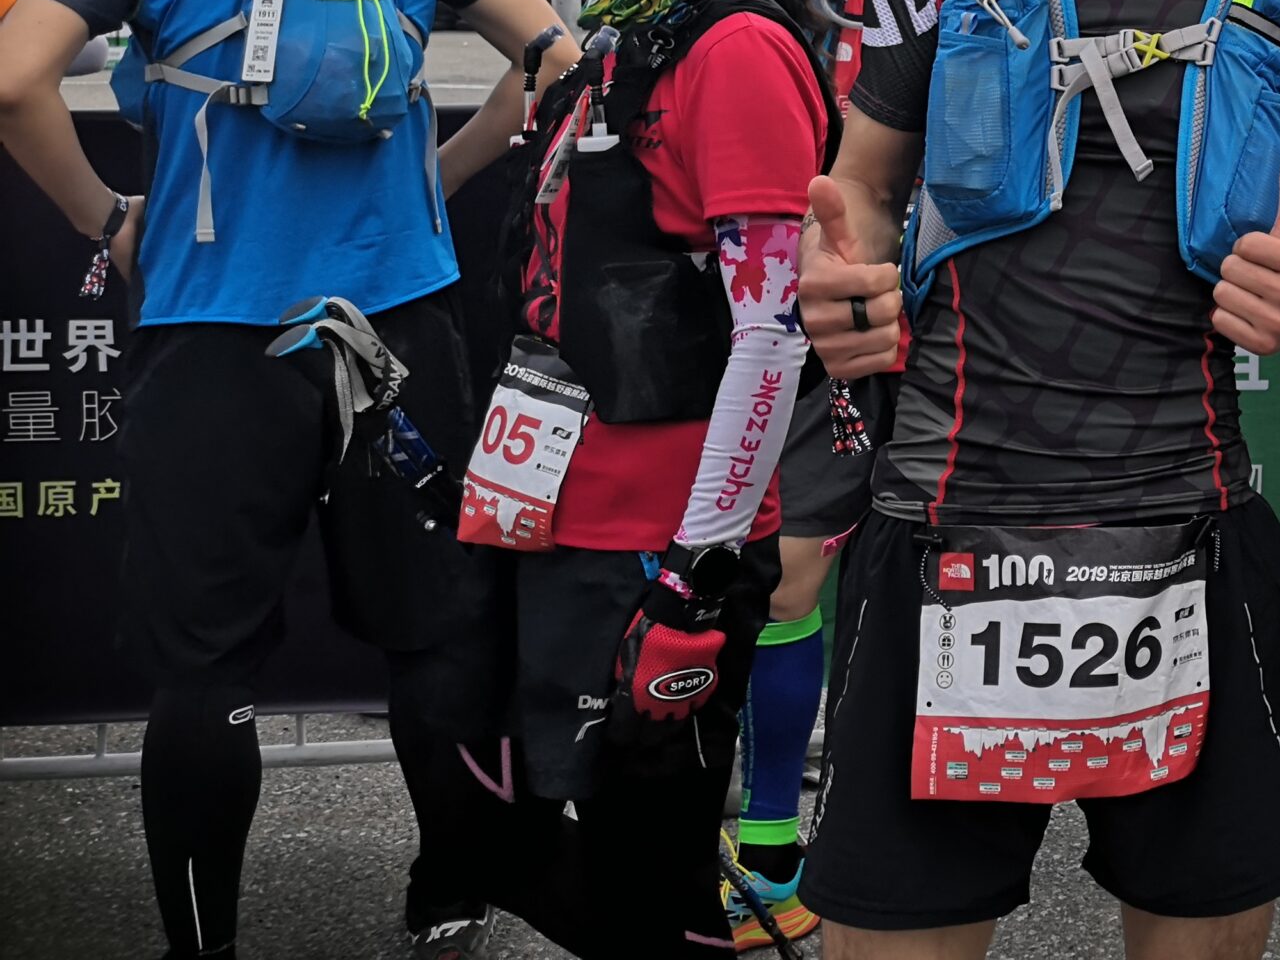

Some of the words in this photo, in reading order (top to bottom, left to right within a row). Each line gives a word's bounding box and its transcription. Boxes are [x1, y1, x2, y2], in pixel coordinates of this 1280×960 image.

[257, 10, 275, 18] 1911
[0, 319, 122, 373] 世界
[2, 388, 122, 442] 量胶
[745, 369, 783, 434] ZONE
[481, 404, 543, 465] 05
[982, 554, 1054, 590] 100
[1065, 566, 1108, 582] 2019
[970, 615, 1163, 688] 1526
[670, 675, 707, 692] SPORT
